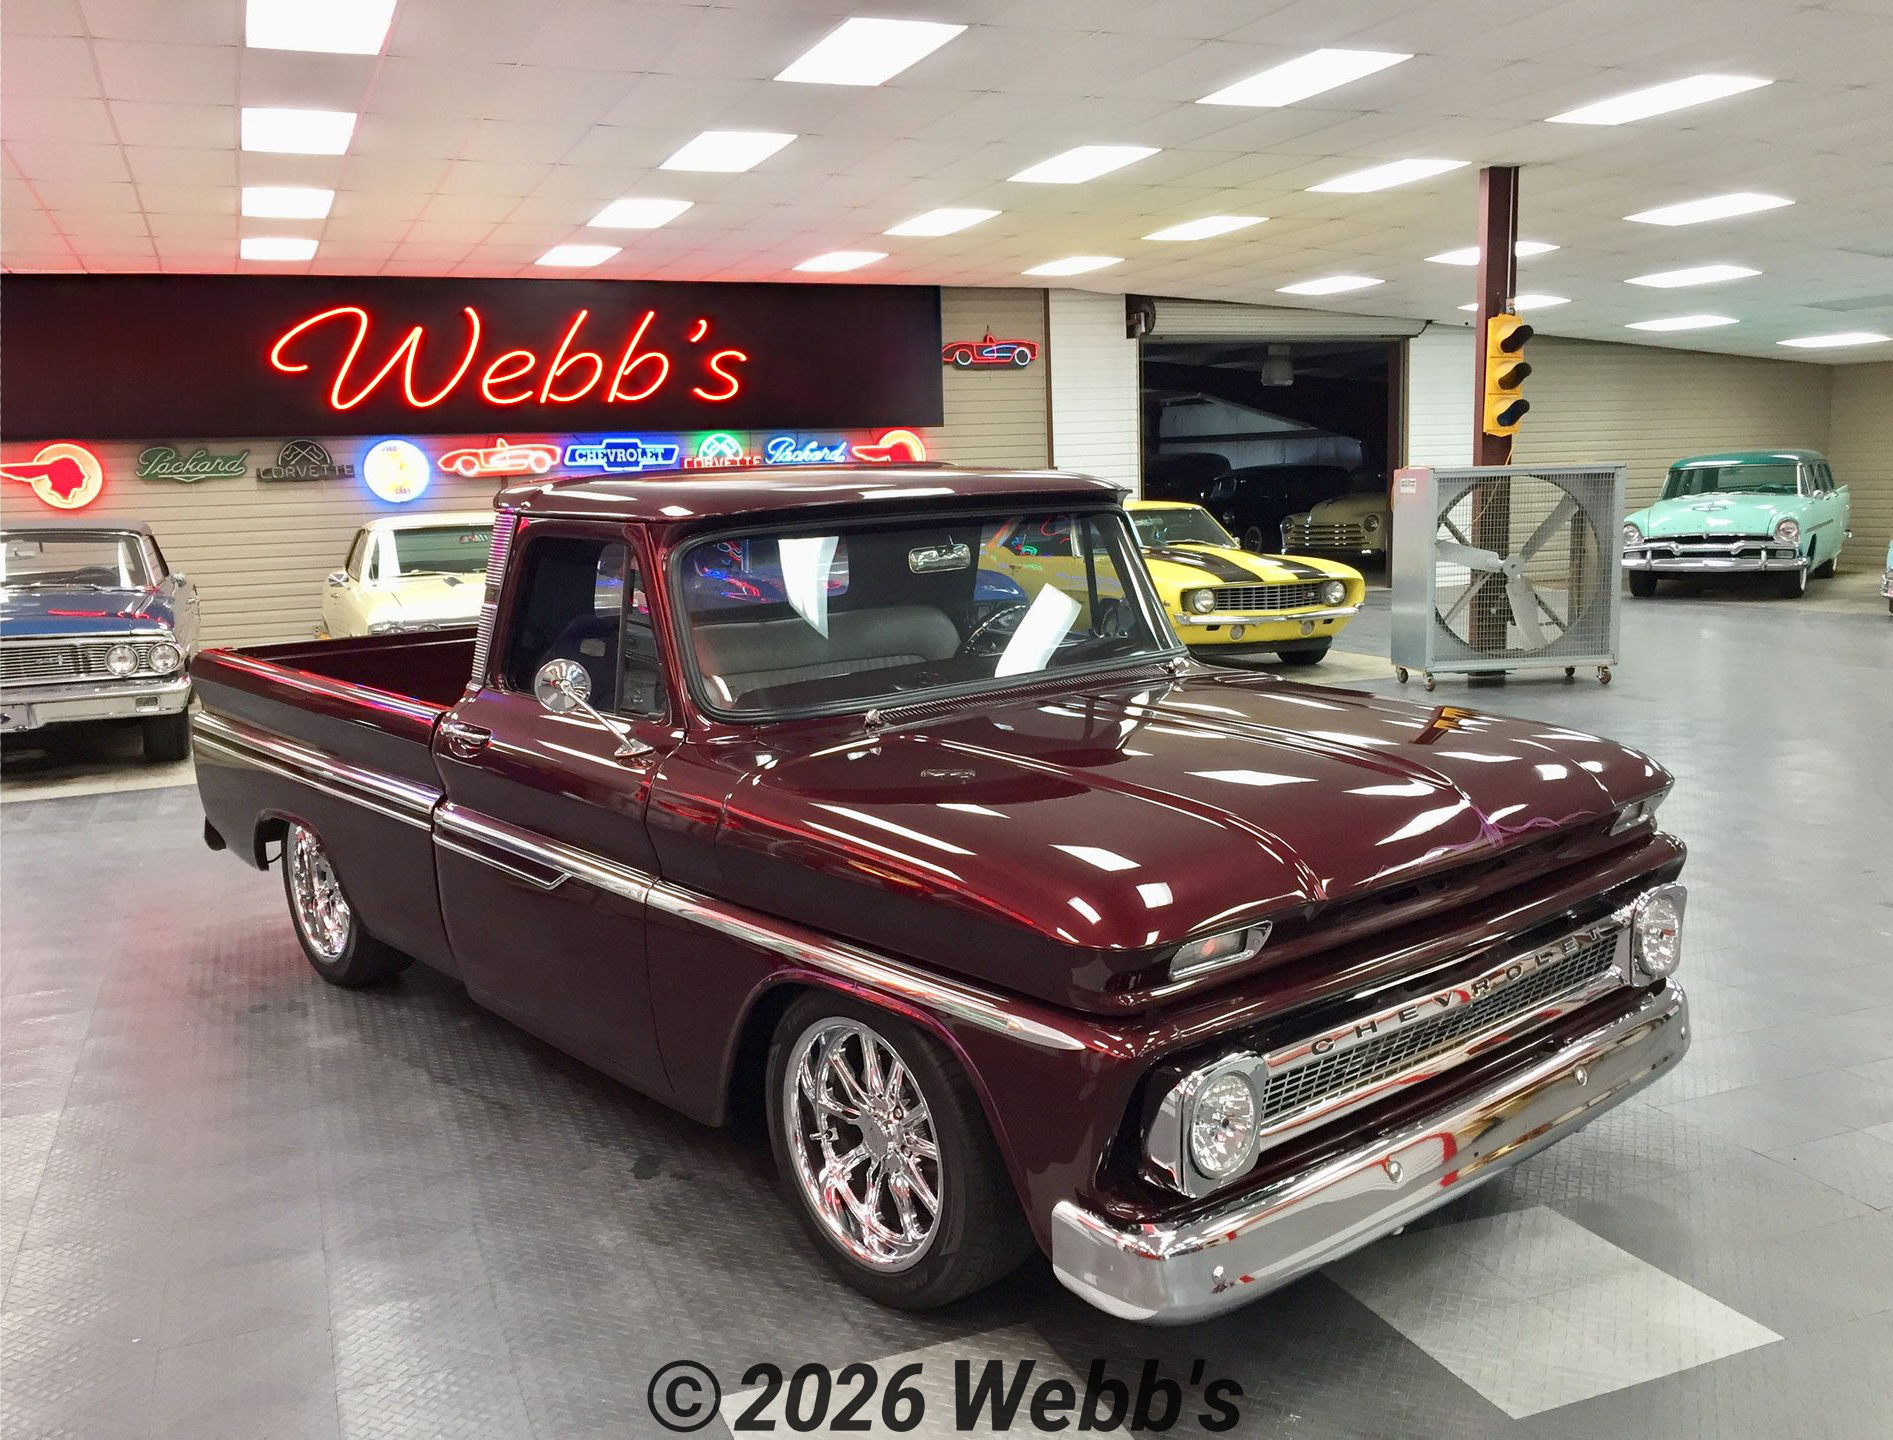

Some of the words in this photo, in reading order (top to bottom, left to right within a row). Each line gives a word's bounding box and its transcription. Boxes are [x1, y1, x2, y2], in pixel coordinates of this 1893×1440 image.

[270, 306, 747, 410] Webb's
[136, 447, 249, 476] Packard
[575, 448, 664, 462] CHEVROLET
[683, 456, 761, 468] CORVETTE
[765, 437, 847, 463] Packard
[260, 464, 354, 479] CORVETTE
[1311, 926, 1603, 1055] CHEVROLET
